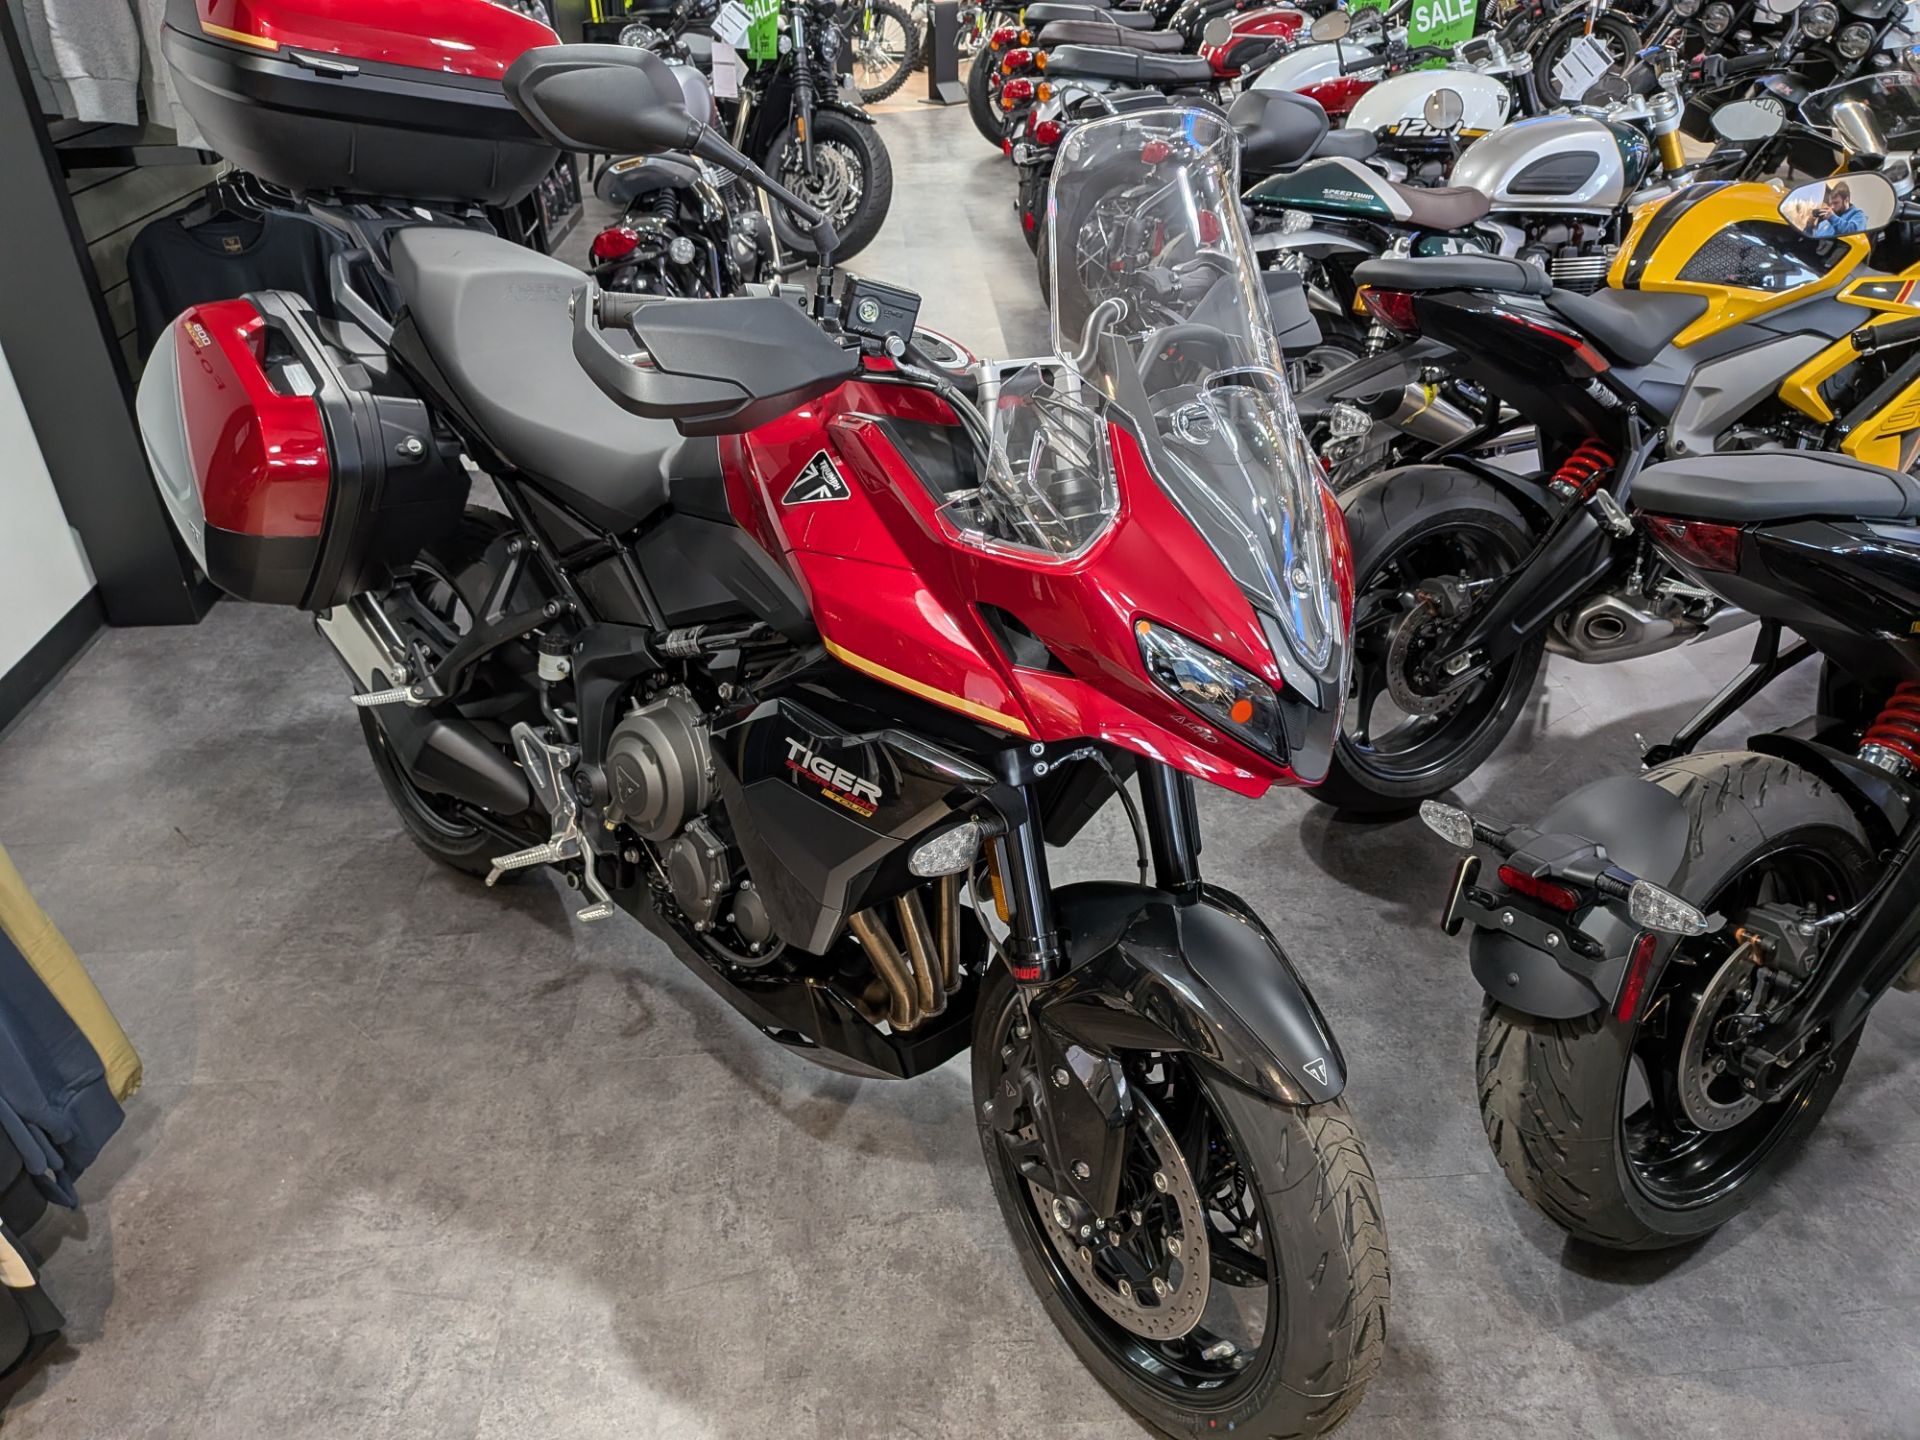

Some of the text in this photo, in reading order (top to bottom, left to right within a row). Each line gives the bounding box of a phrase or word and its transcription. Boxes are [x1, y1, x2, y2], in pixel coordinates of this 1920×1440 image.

[746, 0, 779, 26] SALE
[1415, 0, 1474, 32] SALE
[1322, 188, 1352, 197] SPEED
[1353, 192, 1375, 201] TWIN
[193, 323, 212, 347] 800
[819, 459, 842, 491] TRIUMPH
[785, 736, 883, 806] TIGER
[784, 759, 879, 814] SPORT 800
[831, 792, 872, 816] TOUR
